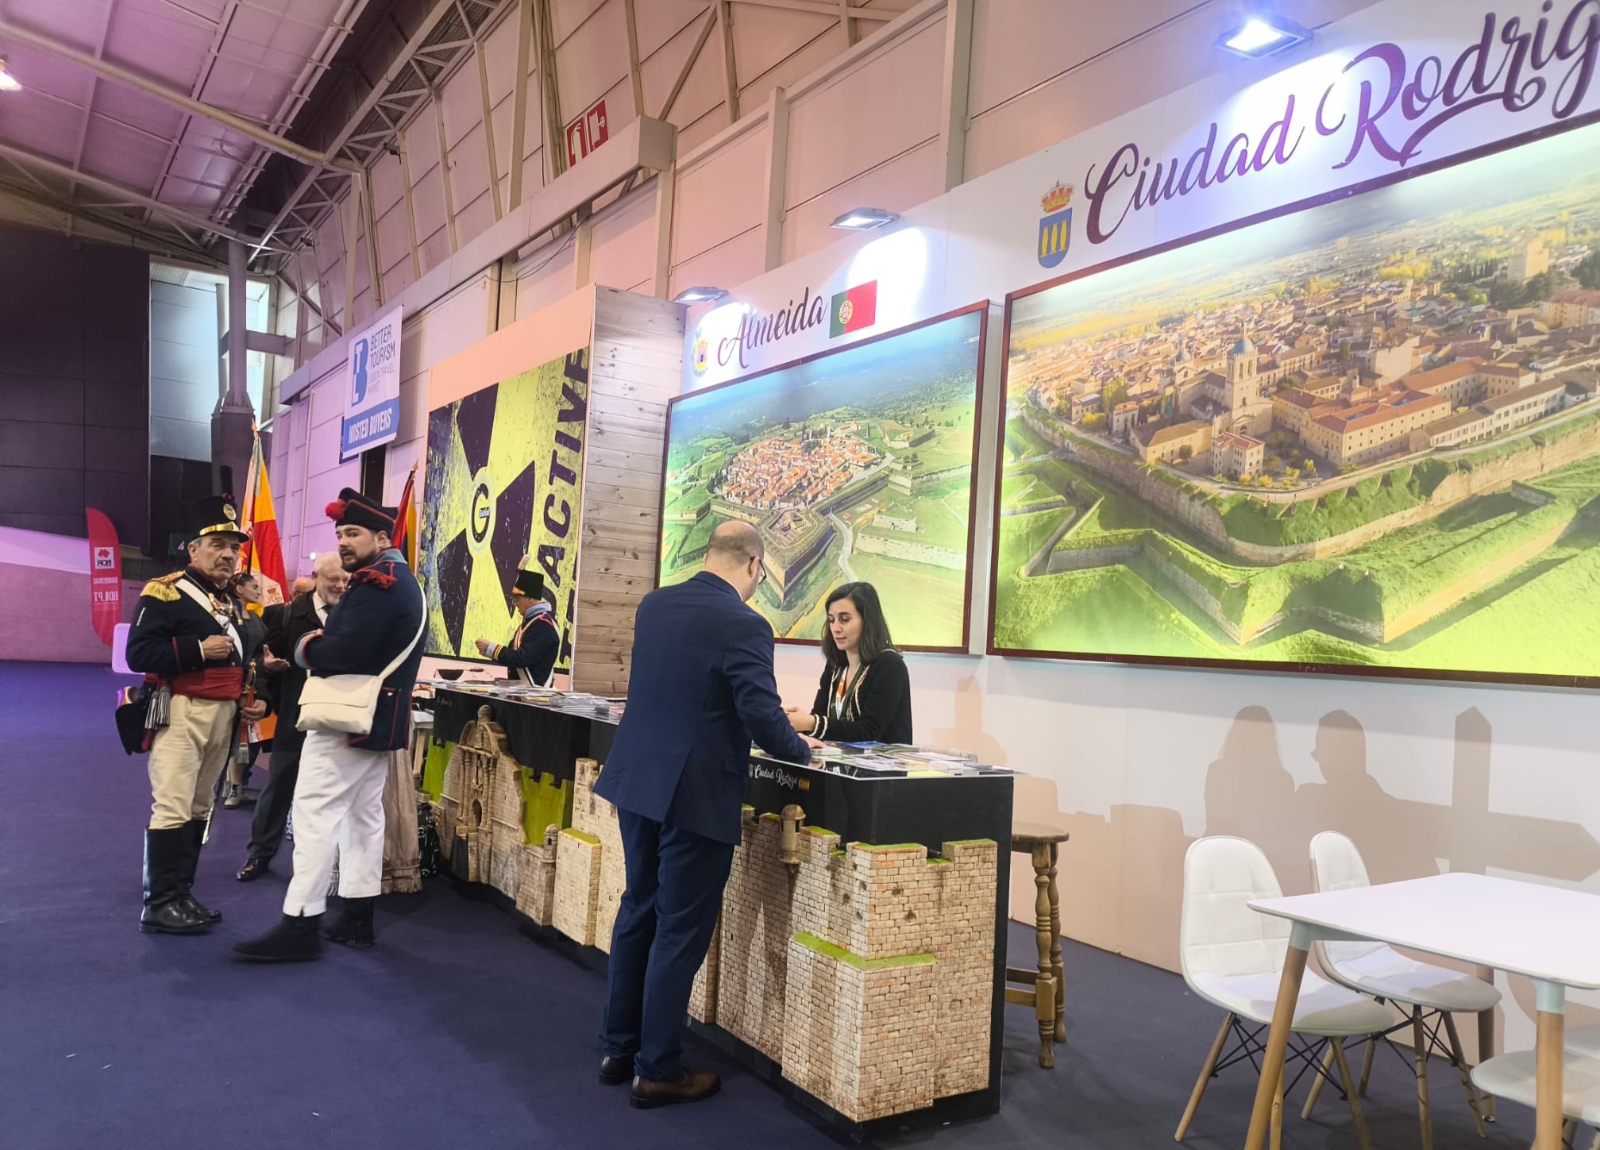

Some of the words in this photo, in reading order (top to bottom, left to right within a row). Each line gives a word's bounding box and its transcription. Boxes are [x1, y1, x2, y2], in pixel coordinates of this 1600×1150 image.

[1084, 94, 1305, 244] Ciudad
[370, 323, 392, 352] BETTER
[717, 287, 828, 369] Almeida
[370, 340, 396, 370] TOURISM
[348, 418, 369, 444] HOSTED
[369, 407, 392, 435] BUYERS
